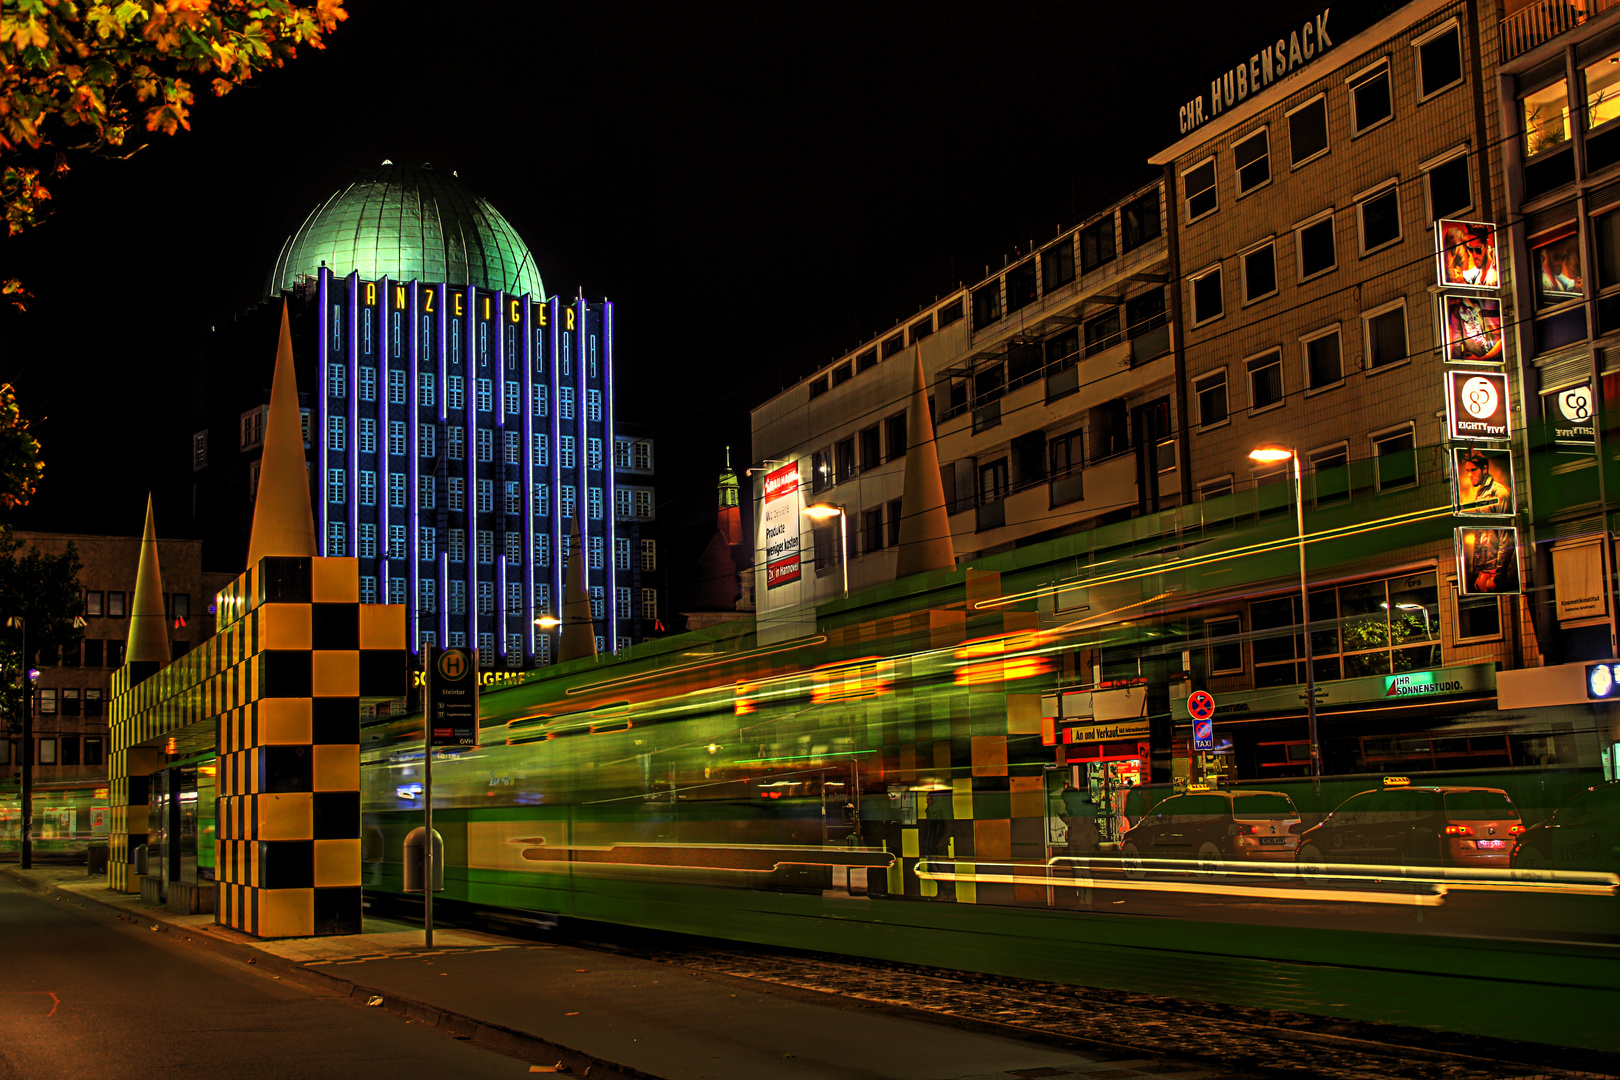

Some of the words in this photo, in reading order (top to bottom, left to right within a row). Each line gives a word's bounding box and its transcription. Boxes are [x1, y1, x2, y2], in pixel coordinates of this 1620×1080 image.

[1179, 95, 1209, 134] CHR.
[1211, 7, 1333, 117] HUBENSACK
[366, 283, 575, 330] ANZEIGER
[1458, 421, 1488, 431] EIGHTY
[1487, 426, 1506, 435] FIVE
[766, 523, 785, 540] Produkte
[784, 537, 798, 551] kosten
[780, 562, 799, 576] Hannover
[1396, 676, 1410, 686] IHR
[1396, 680, 1463, 695] SONNENSTUDIO.
[1075, 731, 1084, 741] An
[1084, 729, 1096, 740] und
[1097, 725, 1119, 739] Verkauf
[1196, 739, 1212, 748] TAXI
